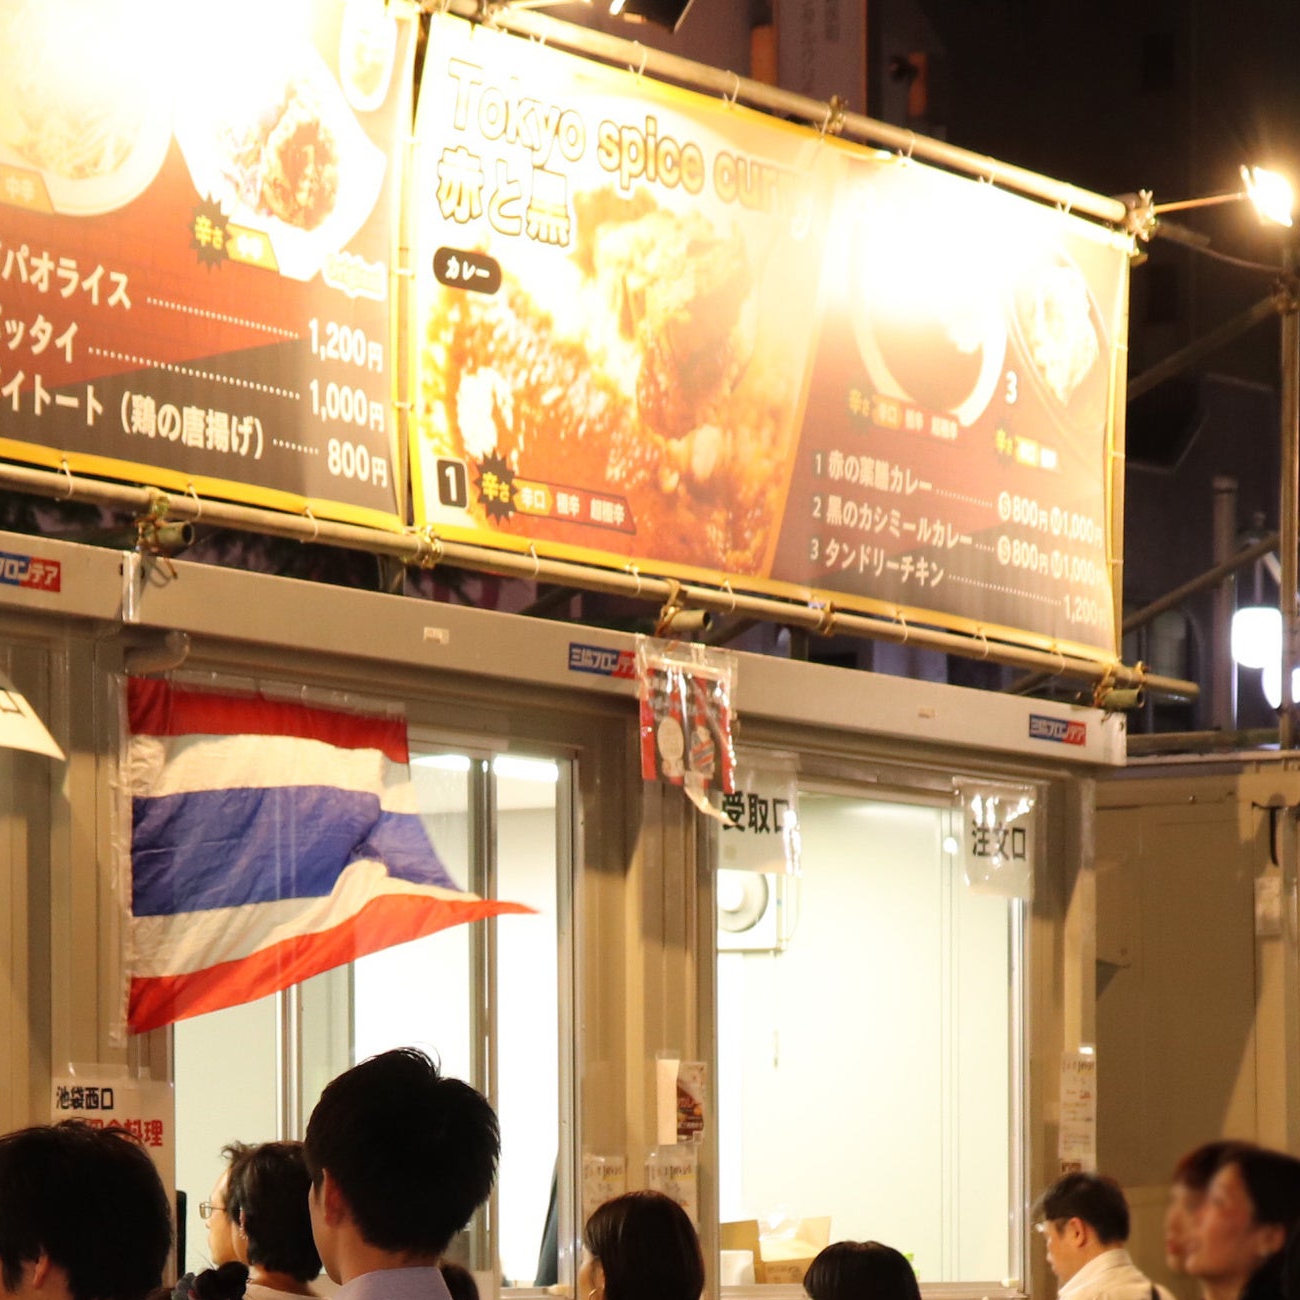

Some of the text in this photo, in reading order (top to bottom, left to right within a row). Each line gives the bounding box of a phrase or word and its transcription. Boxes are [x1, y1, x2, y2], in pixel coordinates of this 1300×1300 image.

[449, 57, 586, 167] Tokyo
[597, 115, 705, 195] spice
[436, 146, 571, 247] 赤と黒
[194, 215, 223, 250] 辛さ
[445, 256, 490, 281] カレー
[308, 318, 384, 374] 1,200円
[309, 378, 385, 432] 1,000円
[1005, 371, 1018, 405] 3
[327, 438, 388, 488] 800円
[445, 466, 458, 503] 1
[828, 450, 932, 495] 赤の薬膳カレー
[482, 472, 510, 503] 辛さ
[521, 487, 546, 510] 辛口
[813, 496, 821, 518] 2
[826, 494, 973, 550] 黒のカシミールカレー
[811, 539, 819, 561] 3
[825, 538, 944, 588] タンドリーチキン
[722, 790, 790, 834] 受取口
[971, 821, 1027, 861] 注文口
[56, 1085, 114, 1110] 池袋西口
